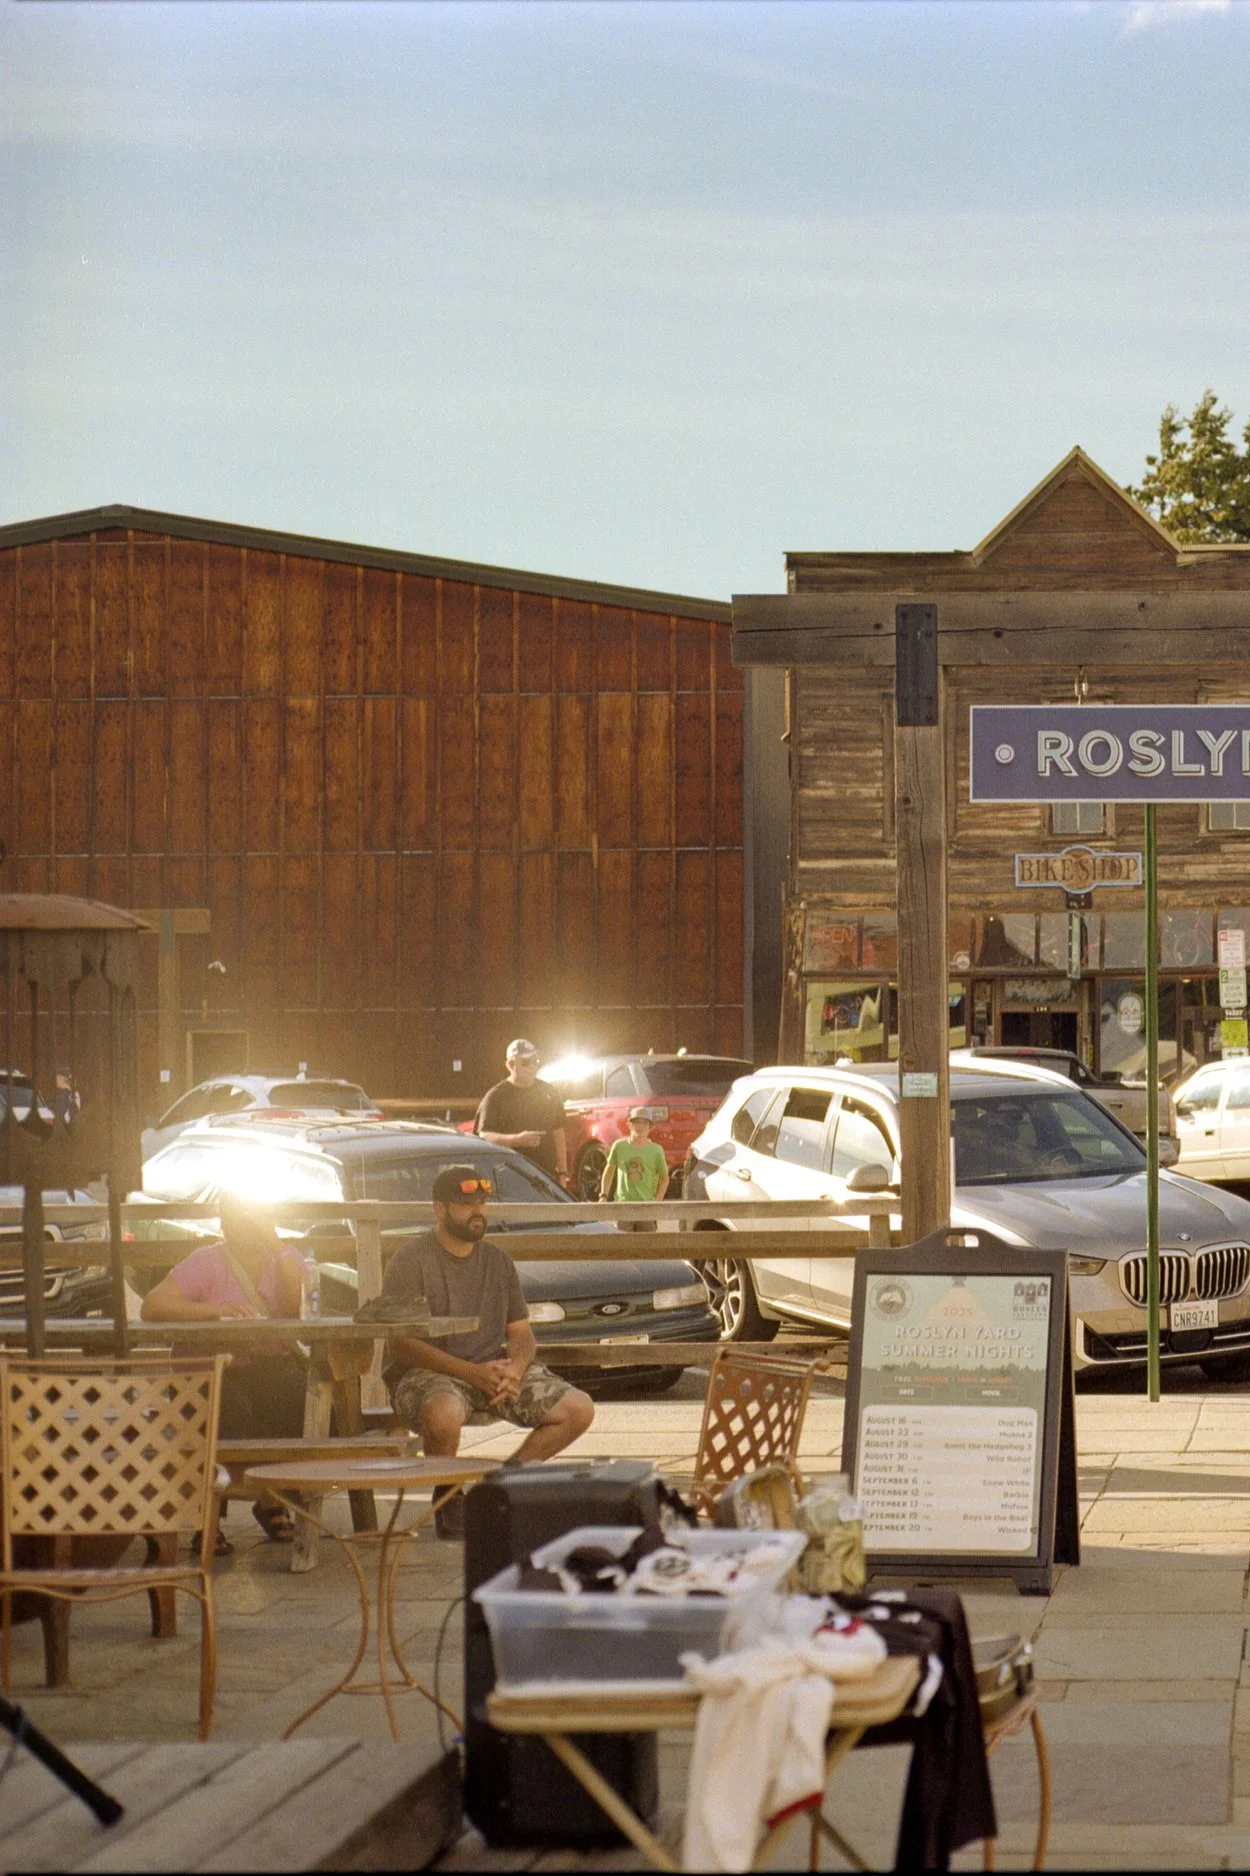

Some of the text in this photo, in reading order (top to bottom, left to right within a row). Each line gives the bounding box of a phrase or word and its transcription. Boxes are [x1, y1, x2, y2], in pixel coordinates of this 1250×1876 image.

[1019, 856, 1138, 881] BIKE SHOP
[1173, 1309, 1215, 1328] CNR9741
[895, 1326, 1021, 1341] ROSLYN YARD
[880, 1342, 1034, 1360] SUMMER NIGHTS
[866, 1415, 896, 1425] AUGUST
[865, 1427, 895, 1437] AUGUST
[897, 1427, 909, 1437] 23
[864, 1440, 894, 1449] AUGUST
[896, 1440, 909, 1448] 29
[864, 1452, 894, 1461] AUGUST
[897, 1452, 909, 1461] 30
[863, 1464, 893, 1473] AUGUST
[863, 1475, 909, 1485] SEPTEMBER
[1006, 1479, 1030, 1487] White
[863, 1523, 906, 1533] EPTEMBER
[908, 1523, 921, 1532] 20
[997, 1526, 1028, 1535] Wicked
